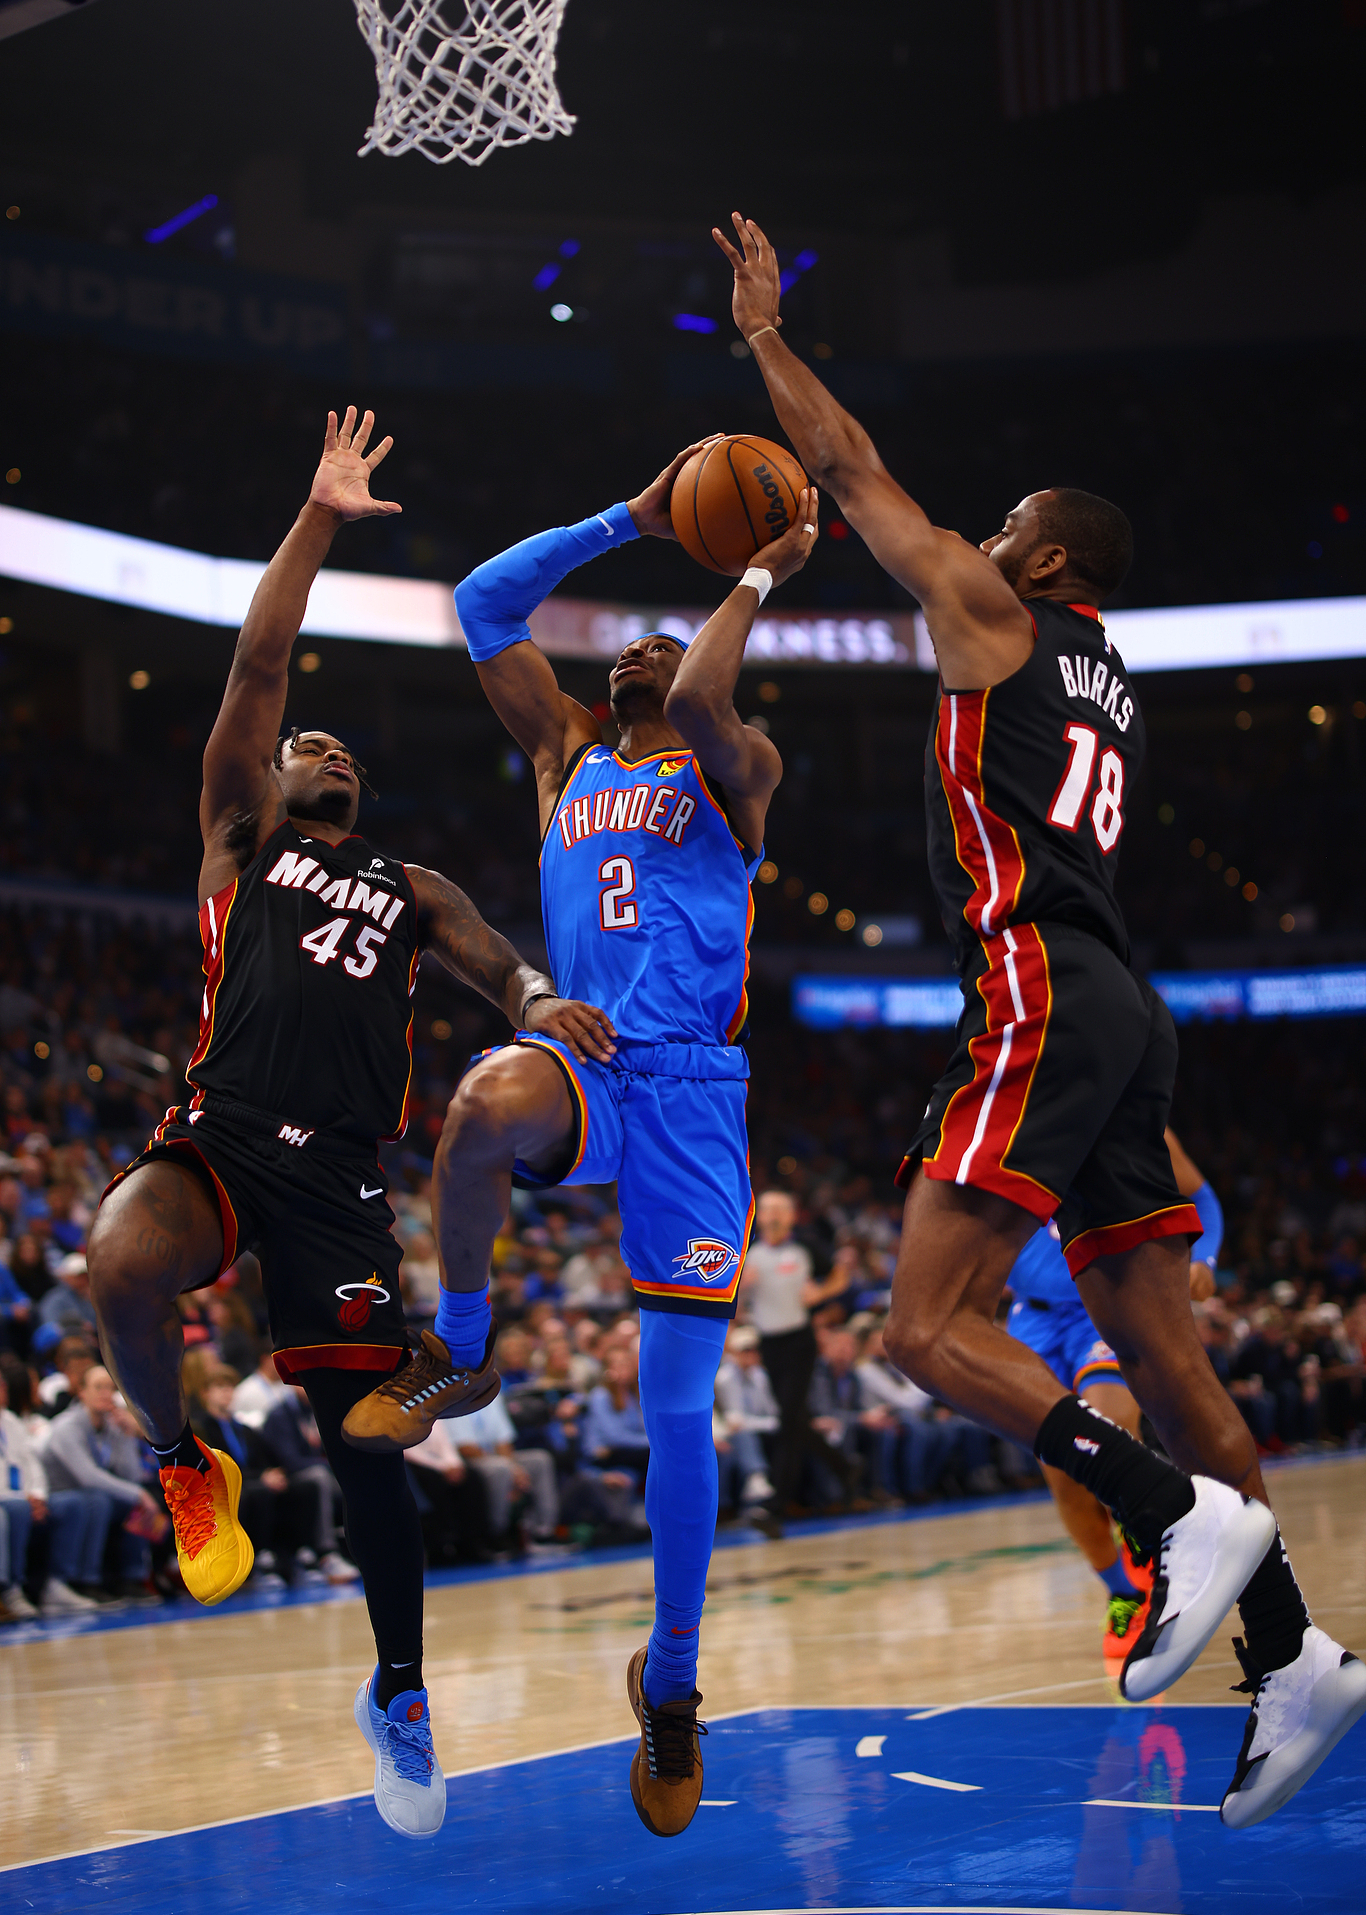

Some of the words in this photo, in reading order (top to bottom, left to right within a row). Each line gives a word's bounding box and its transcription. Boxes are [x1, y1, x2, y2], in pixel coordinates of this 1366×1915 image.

[0, 258, 226, 337] NDER
[240, 296, 345, 350] UP
[1057, 655, 1134, 732] BURKS
[558, 784, 698, 851] THUNDER
[1046, 721, 1125, 856] 18
[264, 849, 407, 932] MIAMI
[357, 869, 397, 887] Robinhood
[599, 854, 638, 931] 2
[299, 915, 389, 980] 45
[685, 1250, 726, 1268] OKC
